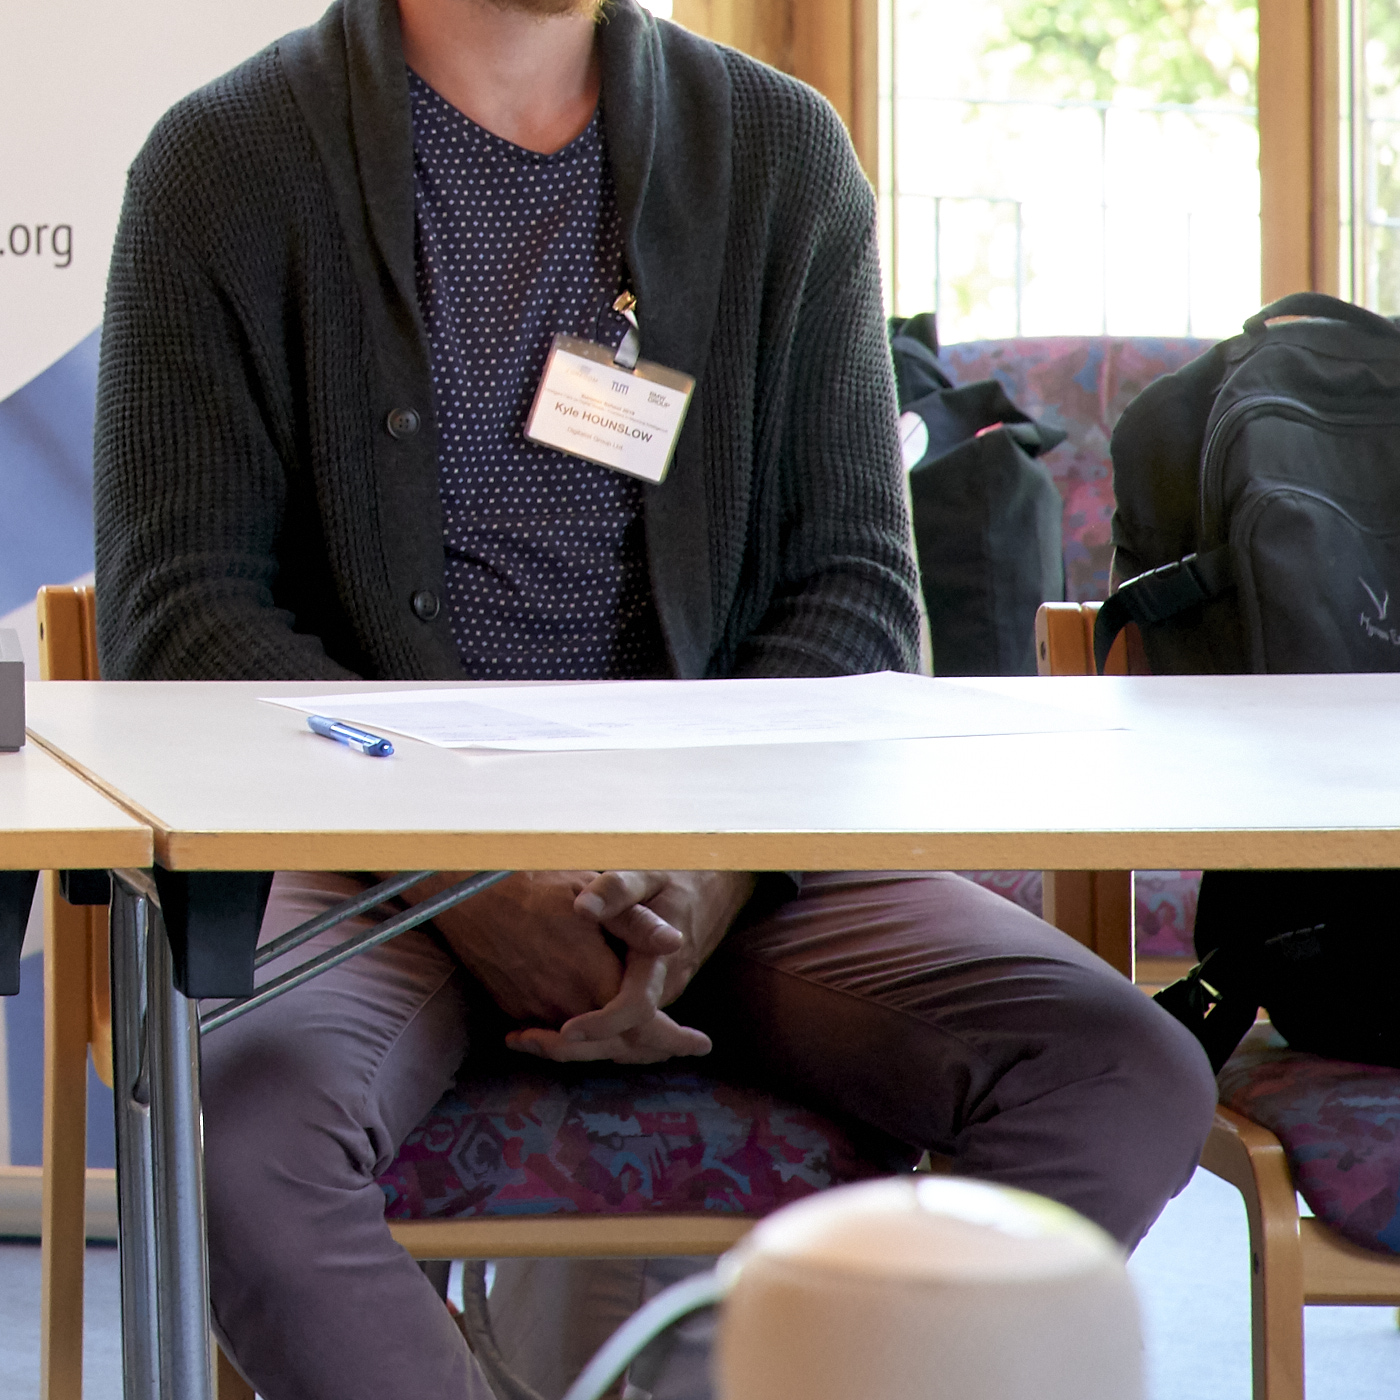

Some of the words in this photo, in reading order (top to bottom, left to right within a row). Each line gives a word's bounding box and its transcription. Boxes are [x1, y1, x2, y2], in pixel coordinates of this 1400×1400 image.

[611, 381, 630, 395] TUM
[555, 402, 579, 418] Kyle
[582, 411, 653, 442] HOUNSLOW
